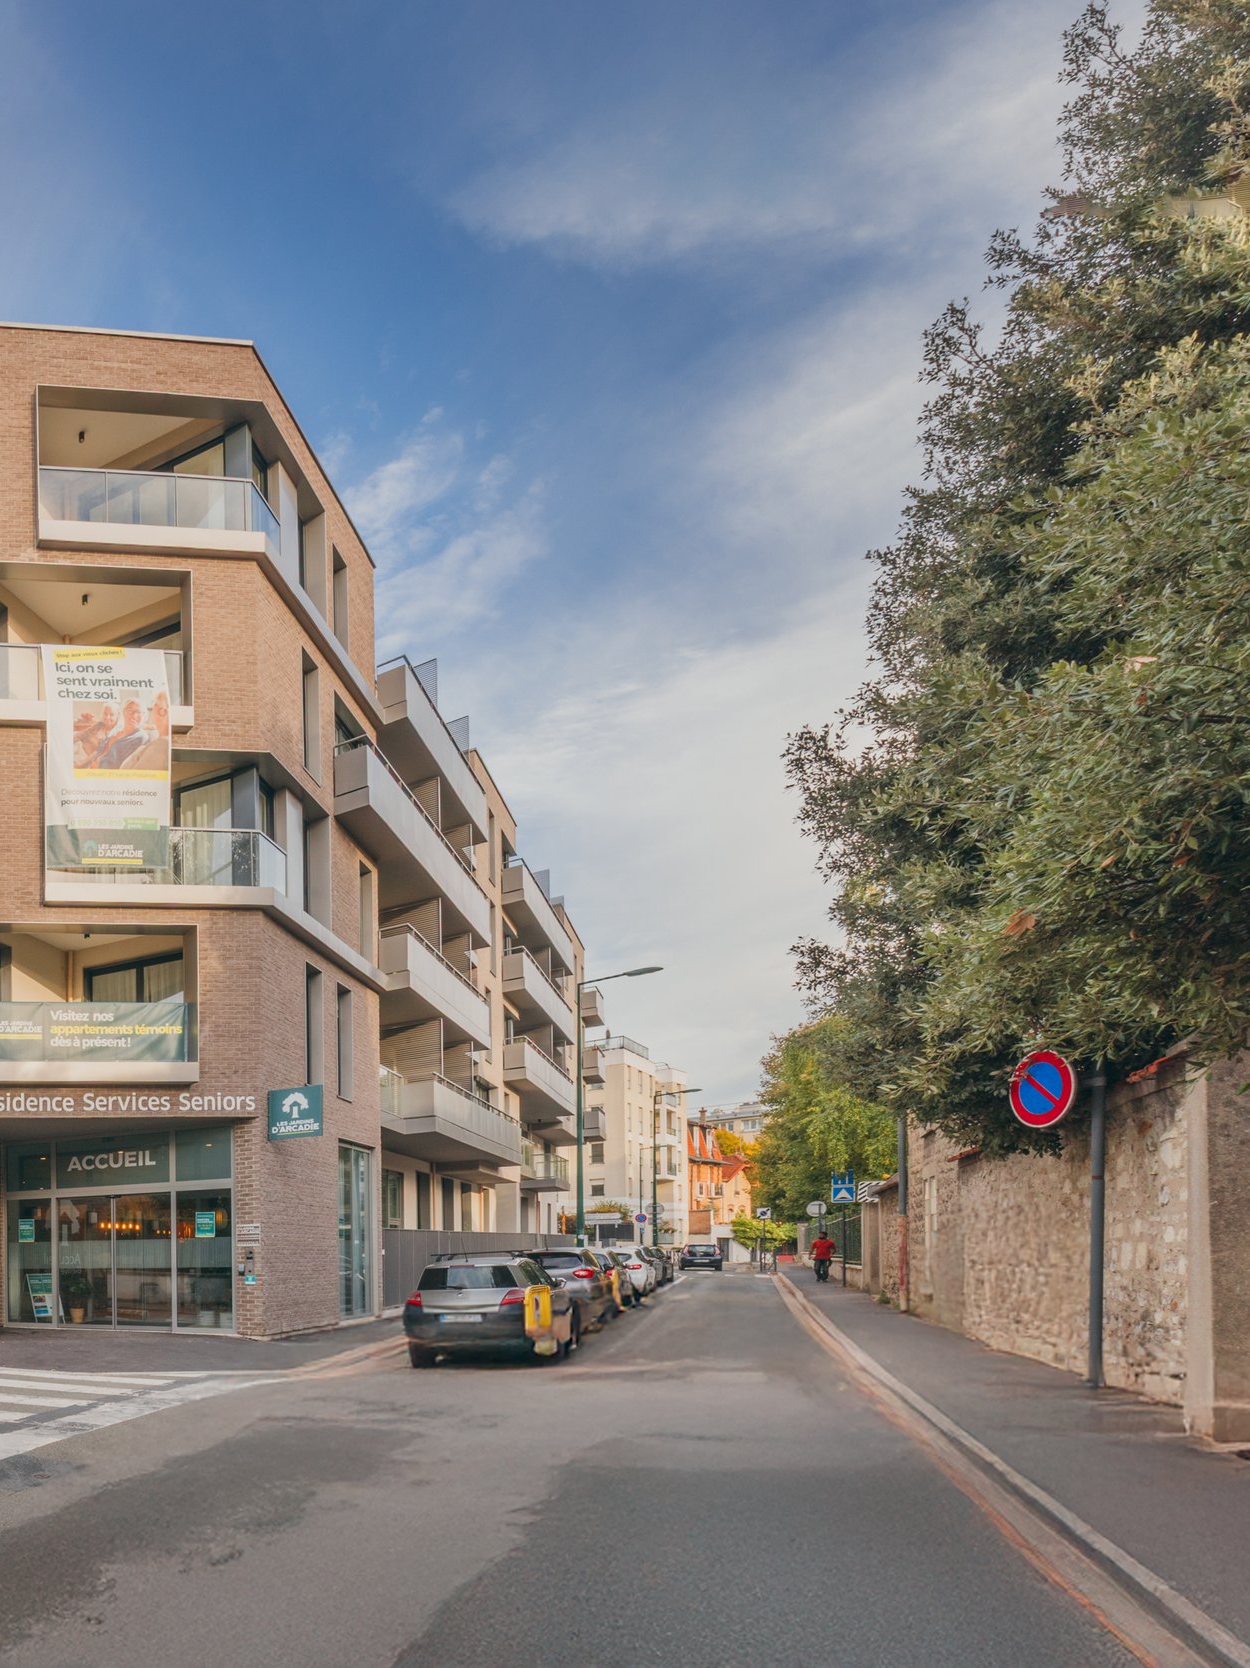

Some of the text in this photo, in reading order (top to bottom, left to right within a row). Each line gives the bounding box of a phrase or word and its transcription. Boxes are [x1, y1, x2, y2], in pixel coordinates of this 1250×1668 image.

[55, 661, 113, 674] Ici, on se
[56, 675, 155, 688] sent vraiment
[57, 688, 118, 700] chez soi.
[122, 788, 158, 797] résidence
[61, 799, 79, 807] pour
[98, 849, 144, 858] D'ARCADIE
[50, 1010, 114, 1022] Visitez nos
[50, 1023, 183, 1037] appartements témoins
[50, 1036, 72, 1048] dès
[73, 1036, 80, 1048] à
[82, 1092, 171, 1112] Services
[178, 1091, 256, 1112] Seniors
[271, 1122, 320, 1134] D'ARCADIE
[288, 1118, 315, 1126] JARDINS
[66, 1149, 157, 1172] ACCUEIL
